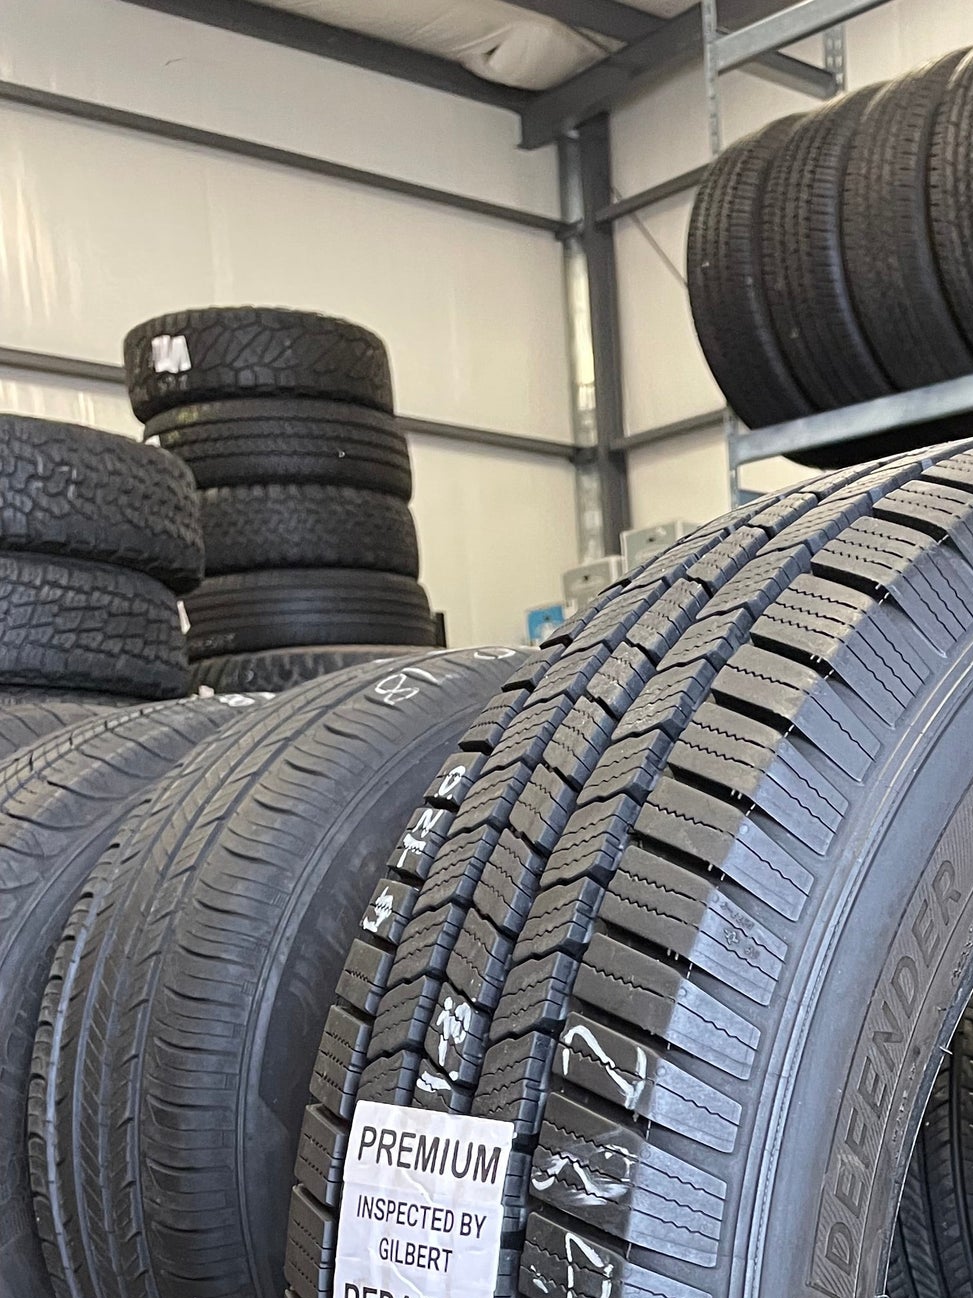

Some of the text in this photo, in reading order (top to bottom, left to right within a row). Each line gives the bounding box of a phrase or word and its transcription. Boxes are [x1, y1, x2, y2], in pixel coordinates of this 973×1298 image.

[824, 859, 962, 1276] DEFENDER
[358, 1125, 502, 1185] PREMIUM
[356, 1194, 488, 1240] INSPECTED BY
[378, 1237, 453, 1273] GILBERT
